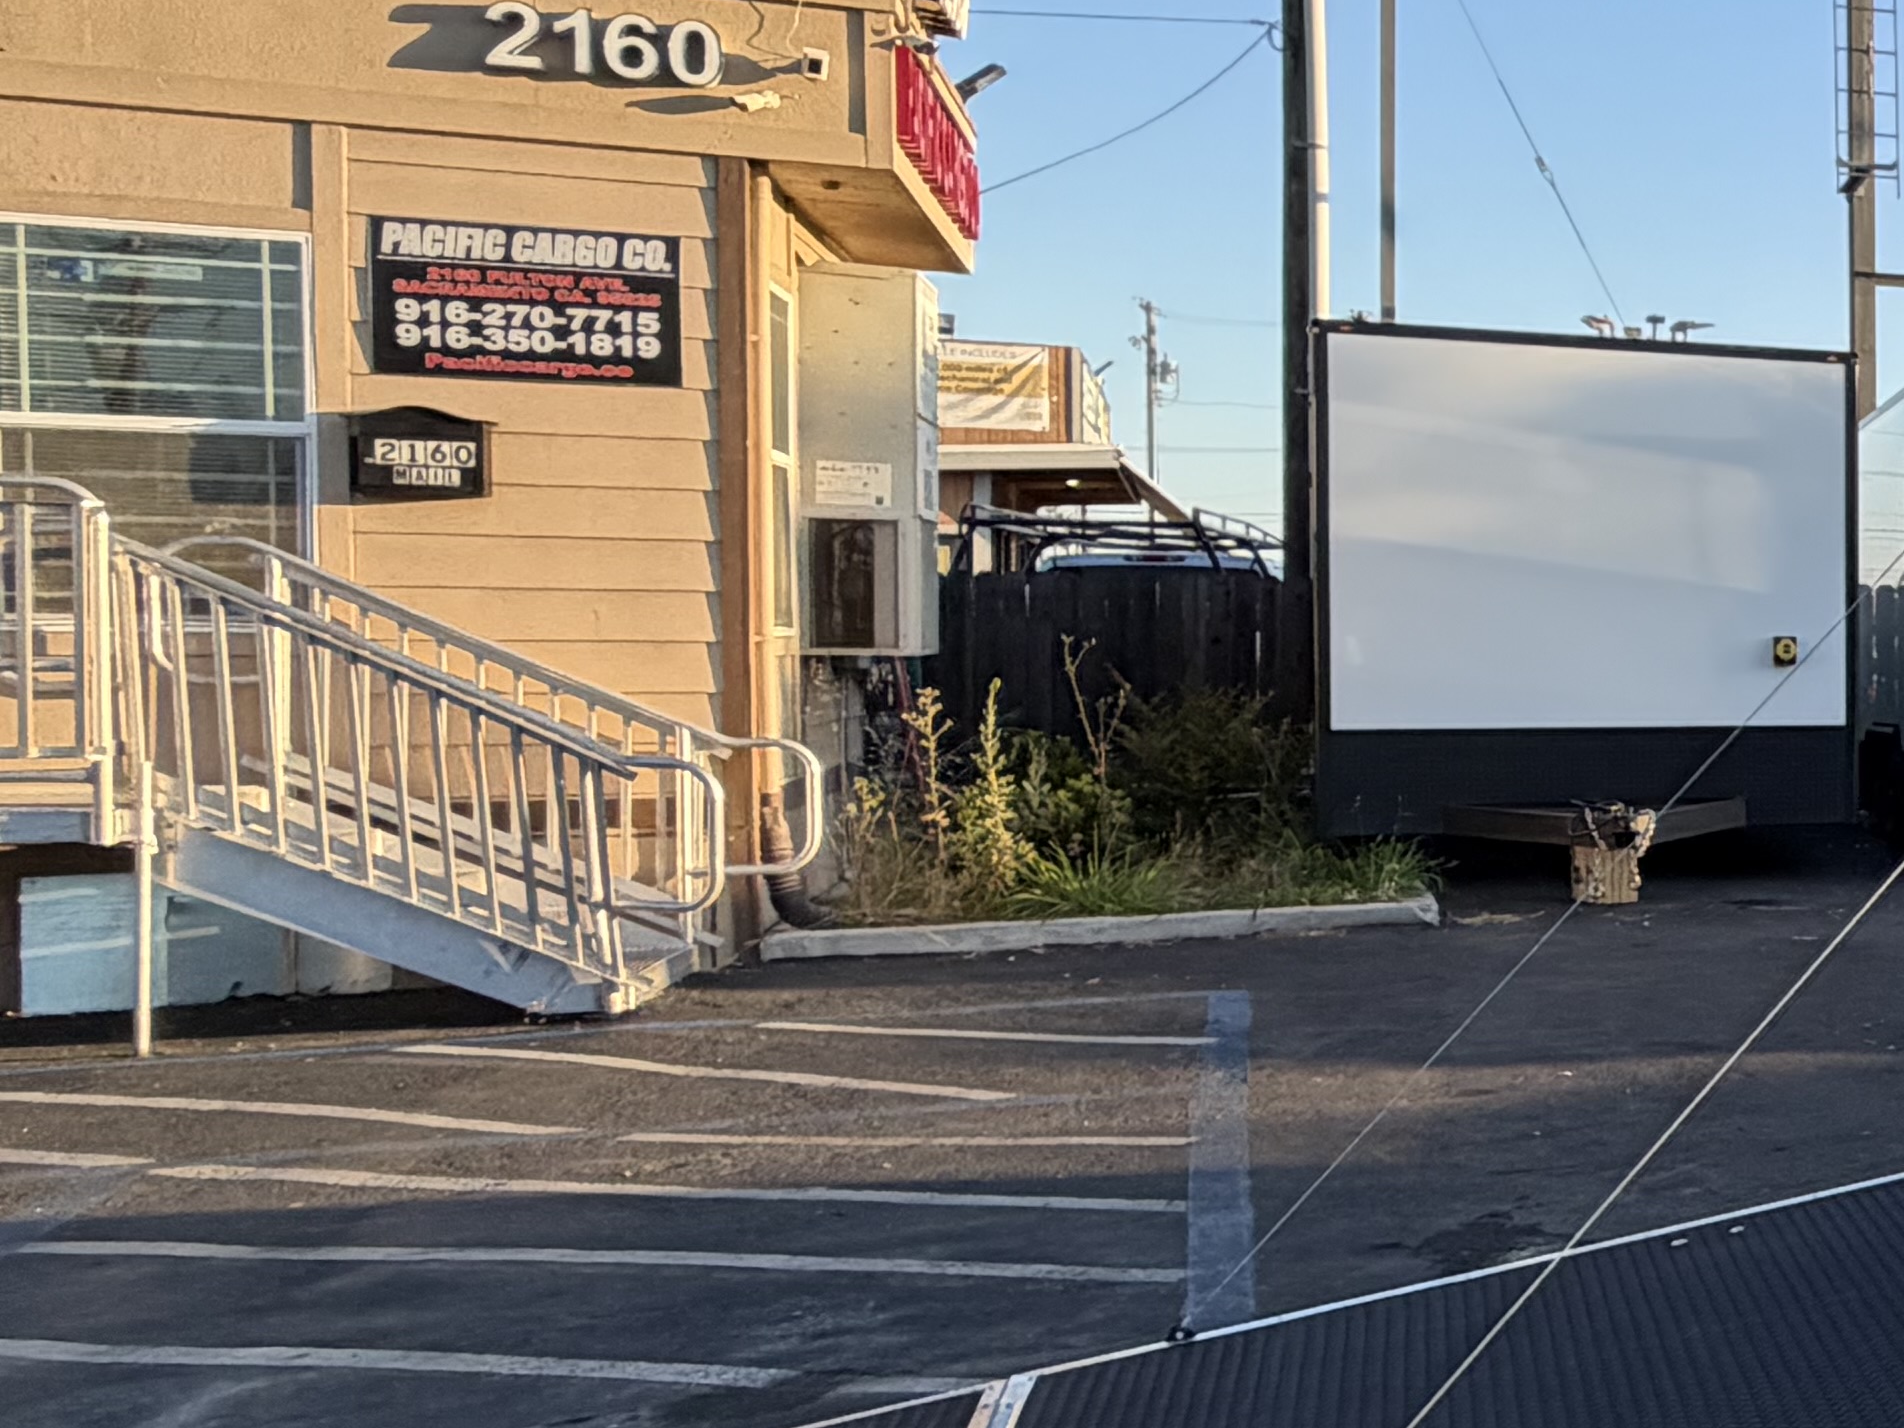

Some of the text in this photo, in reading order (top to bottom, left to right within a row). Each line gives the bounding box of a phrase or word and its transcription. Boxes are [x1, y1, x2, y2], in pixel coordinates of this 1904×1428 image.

[484, 0, 722, 87] 2160
[380, 221, 672, 272] PACIFIC CARGO CO.
[392, 278, 550, 300] SACRAMENTO
[487, 269, 575, 288] FULTON
[394, 297, 662, 335] 916-270-7715
[394, 323, 662, 360] 916-350-1819
[379, 440, 474, 465] 2160
[394, 467, 460, 485] MAIL
